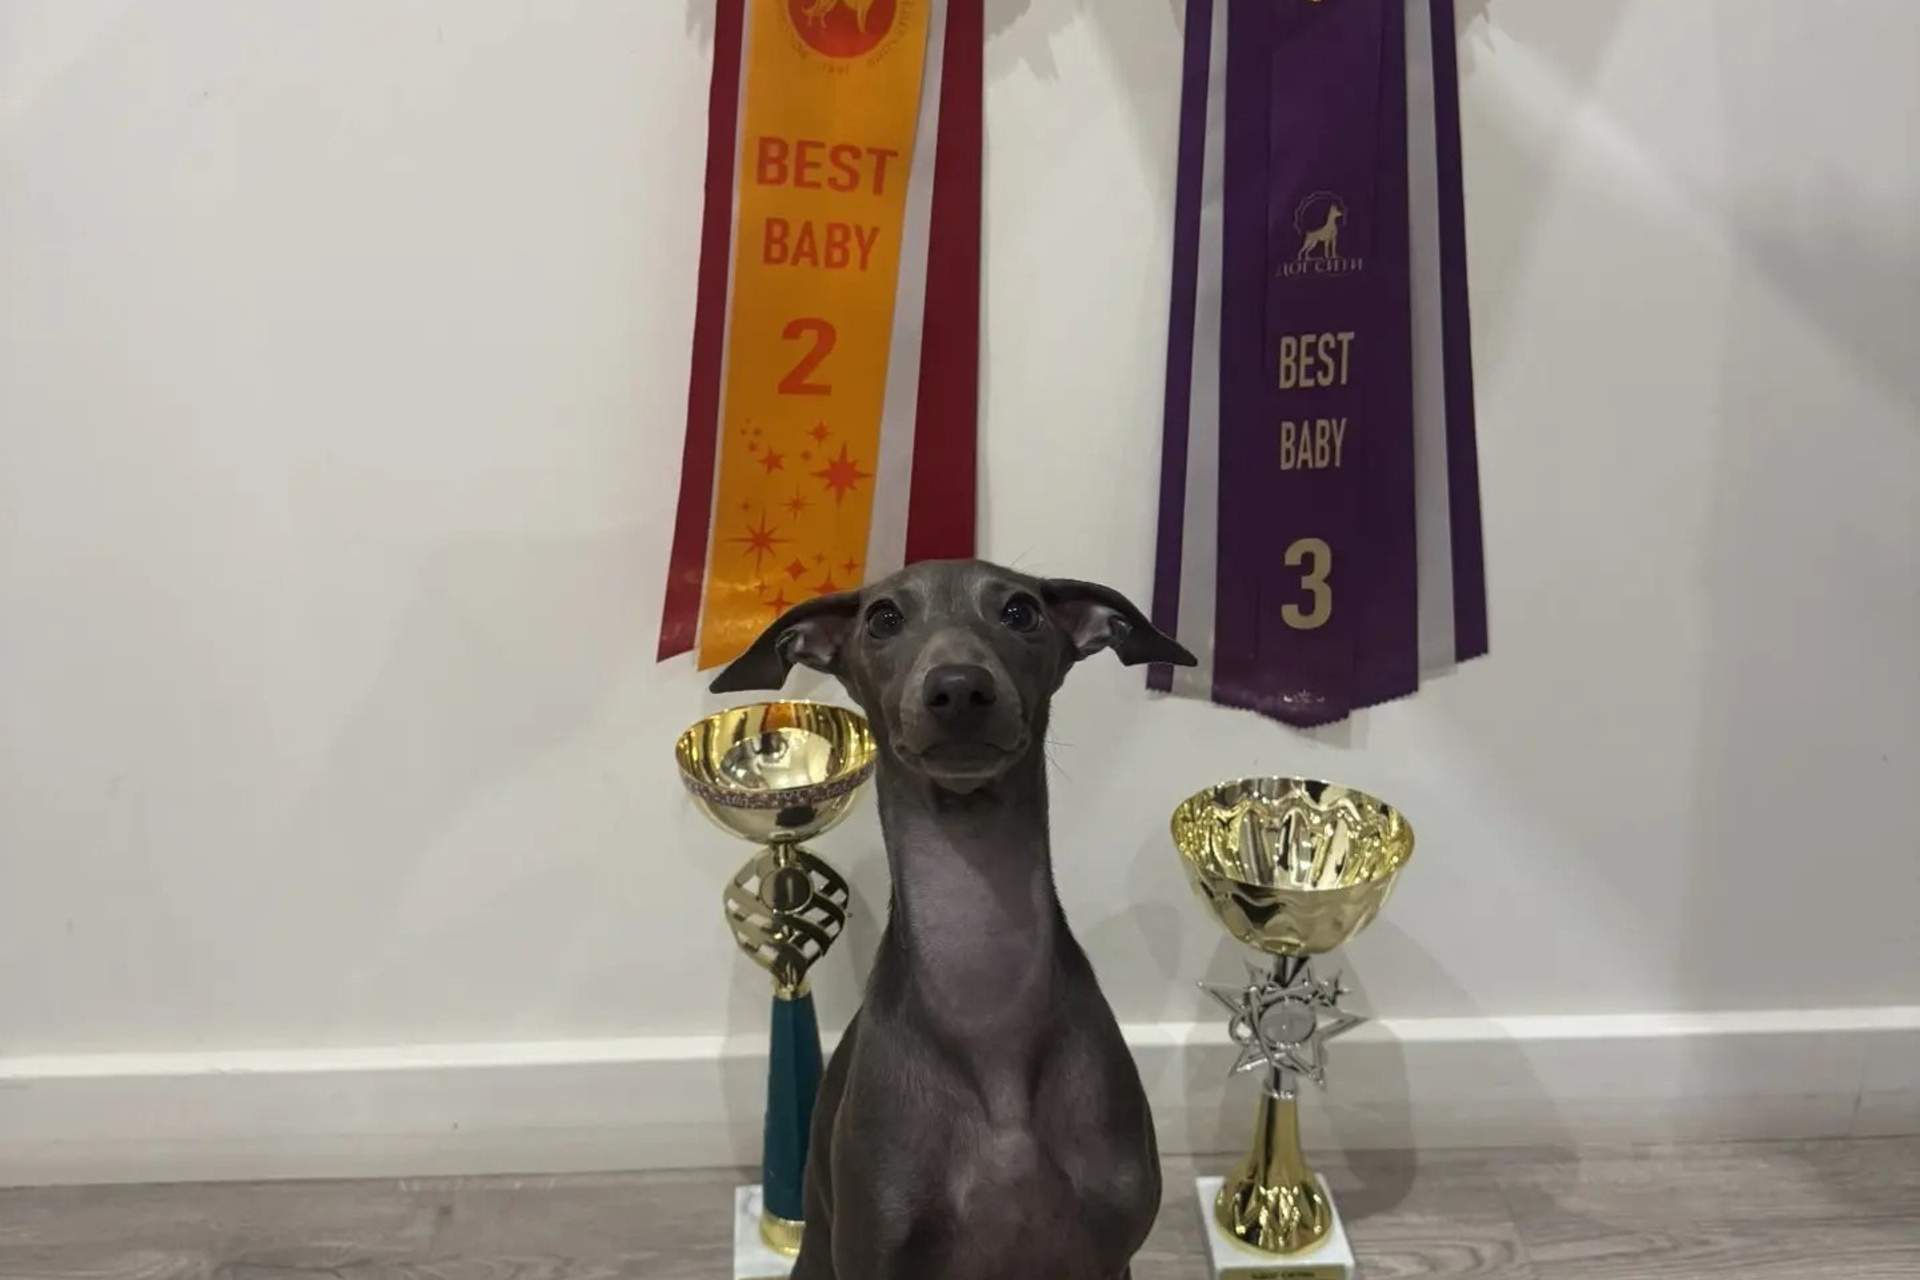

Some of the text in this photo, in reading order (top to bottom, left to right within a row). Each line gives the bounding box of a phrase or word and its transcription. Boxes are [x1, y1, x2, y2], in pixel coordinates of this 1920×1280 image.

[756, 136, 899, 196] BEST
[762, 216, 881, 272] BABY
[777, 317, 837, 396] 2
[1279, 331, 1355, 389] BEST
[1280, 417, 1347, 470] BABY
[1281, 537, 1332, 630] 3
